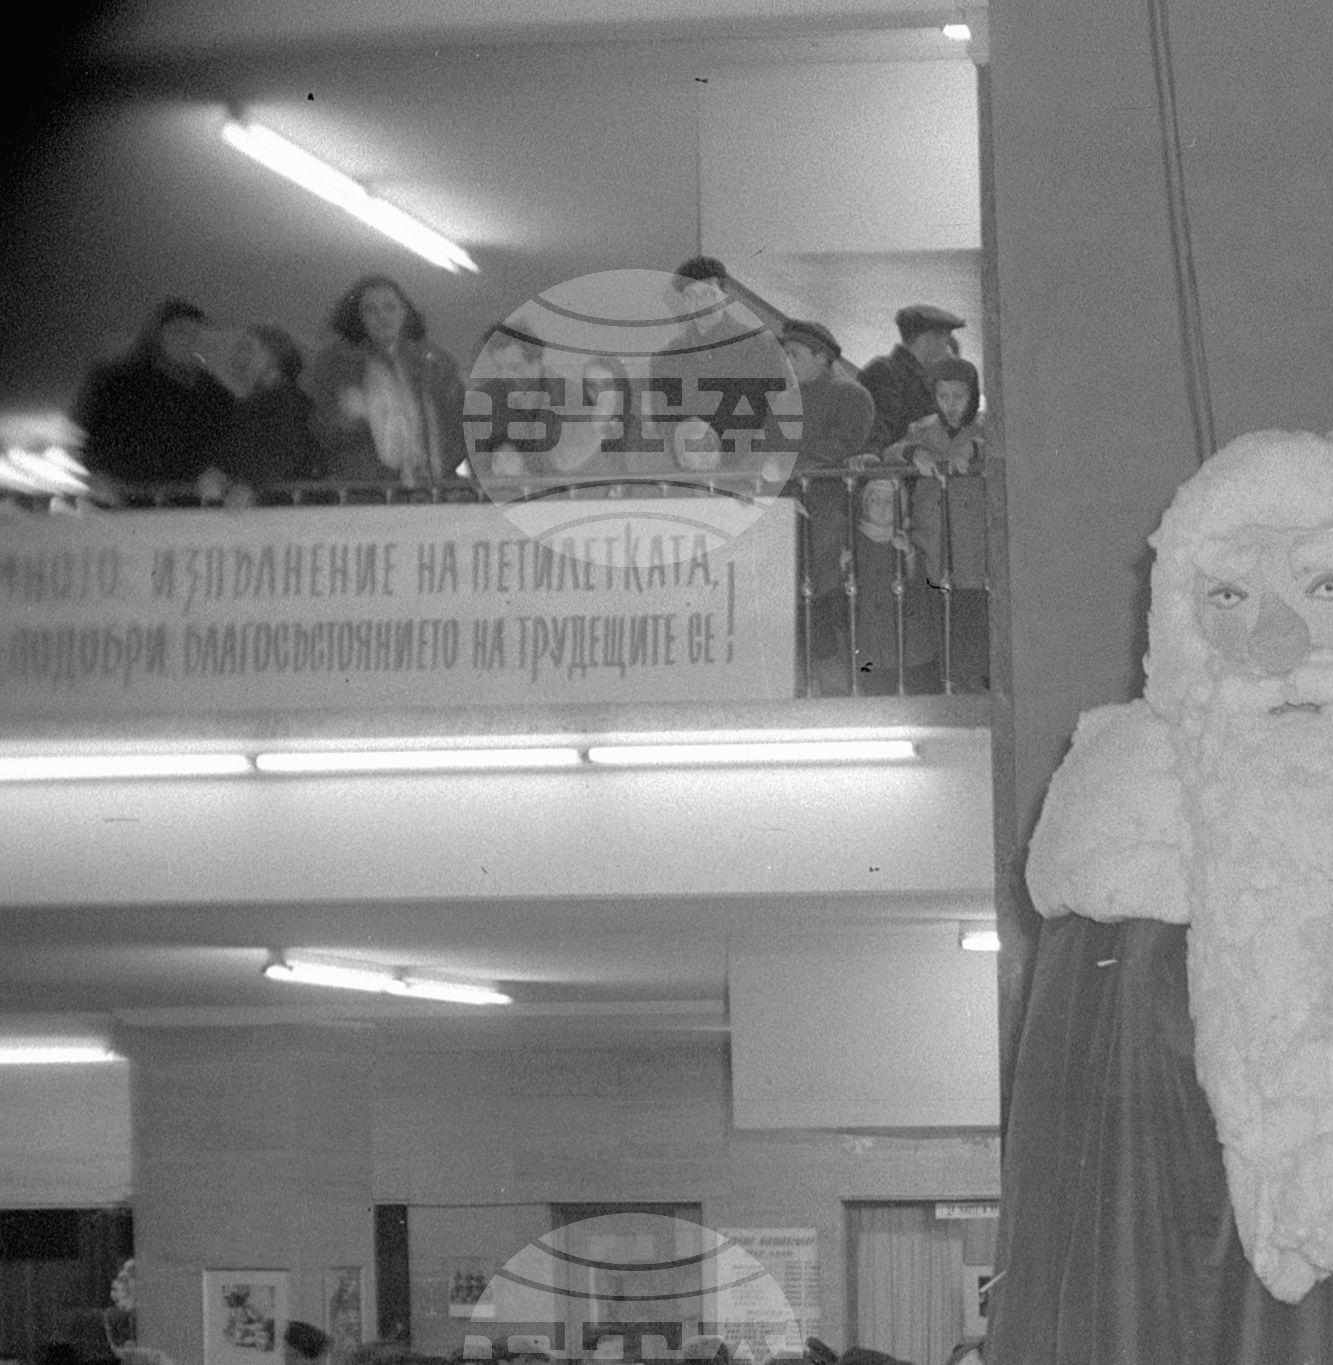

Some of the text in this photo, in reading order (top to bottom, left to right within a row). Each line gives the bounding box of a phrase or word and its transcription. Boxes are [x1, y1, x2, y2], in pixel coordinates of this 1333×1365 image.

[152, 542, 399, 616] ИЗПЪЛНЕНИЕ
[417, 540, 458, 594] НА
[184, 617, 460, 676] БЛАГОСЪСТОЯНИЕТО
[472, 616, 506, 670] НА
[518, 612, 677, 685] ТРУДЕЩИТЕ
